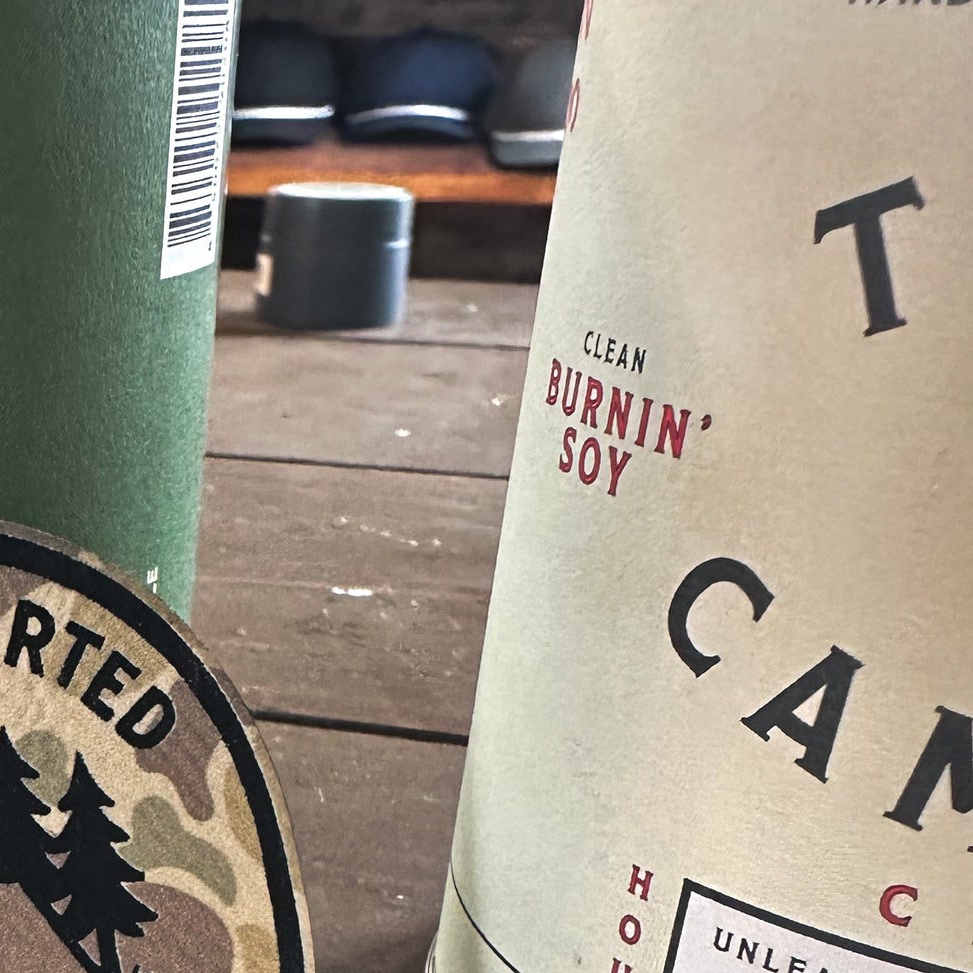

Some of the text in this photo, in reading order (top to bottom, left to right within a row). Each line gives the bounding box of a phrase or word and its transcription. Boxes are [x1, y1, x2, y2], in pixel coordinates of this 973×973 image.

[583, 330, 647, 374] CLEAN
[545, 358, 712, 459] BURNIN'
[558, 427, 632, 497] SOY
